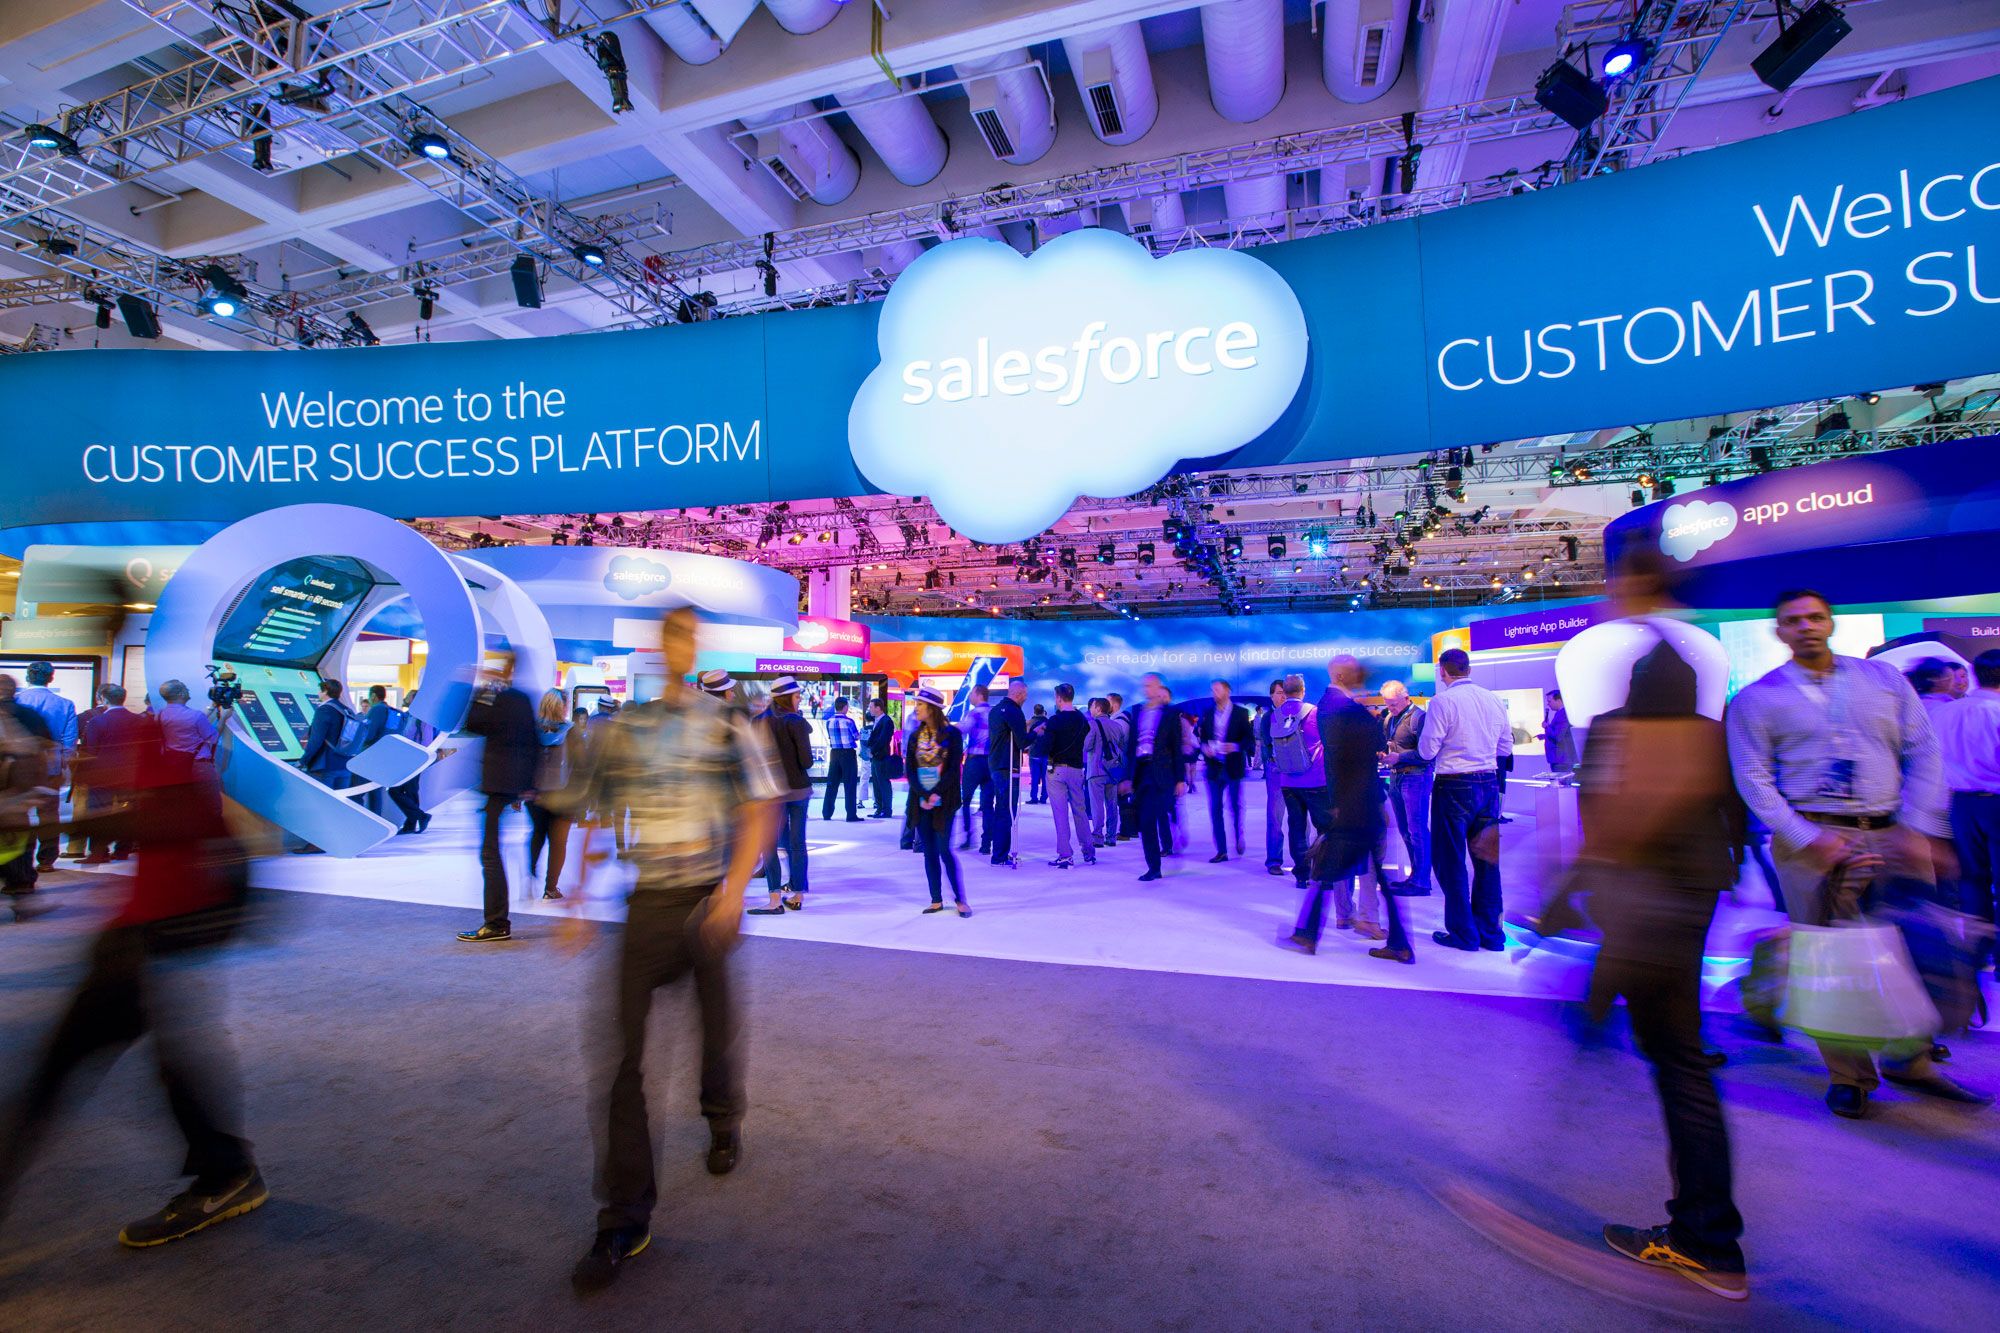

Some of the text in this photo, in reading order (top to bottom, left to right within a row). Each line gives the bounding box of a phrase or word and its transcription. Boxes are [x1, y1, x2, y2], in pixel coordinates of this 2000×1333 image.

[1438, 268, 1876, 391] CUSTOMER
[902, 321, 1259, 406] salesforce
[261, 381, 566, 429] Welcome to the
[83, 419, 761, 483] CUSTOMER SUCCESS PLATFORM
[1667, 483, 1874, 539] salesforce app cloud
[613, 570, 666, 584] salesforce
[829, 631, 851, 643] service
[851, 633, 863, 644] cloud
[1504, 616, 1589, 639] Lightning App Builder
[1971, 626, 2000, 637] Build
[1084, 643, 1422, 667] Get ready for a new kind of customer success.
[759, 664, 820, 673] 276 CASES CLOSED
